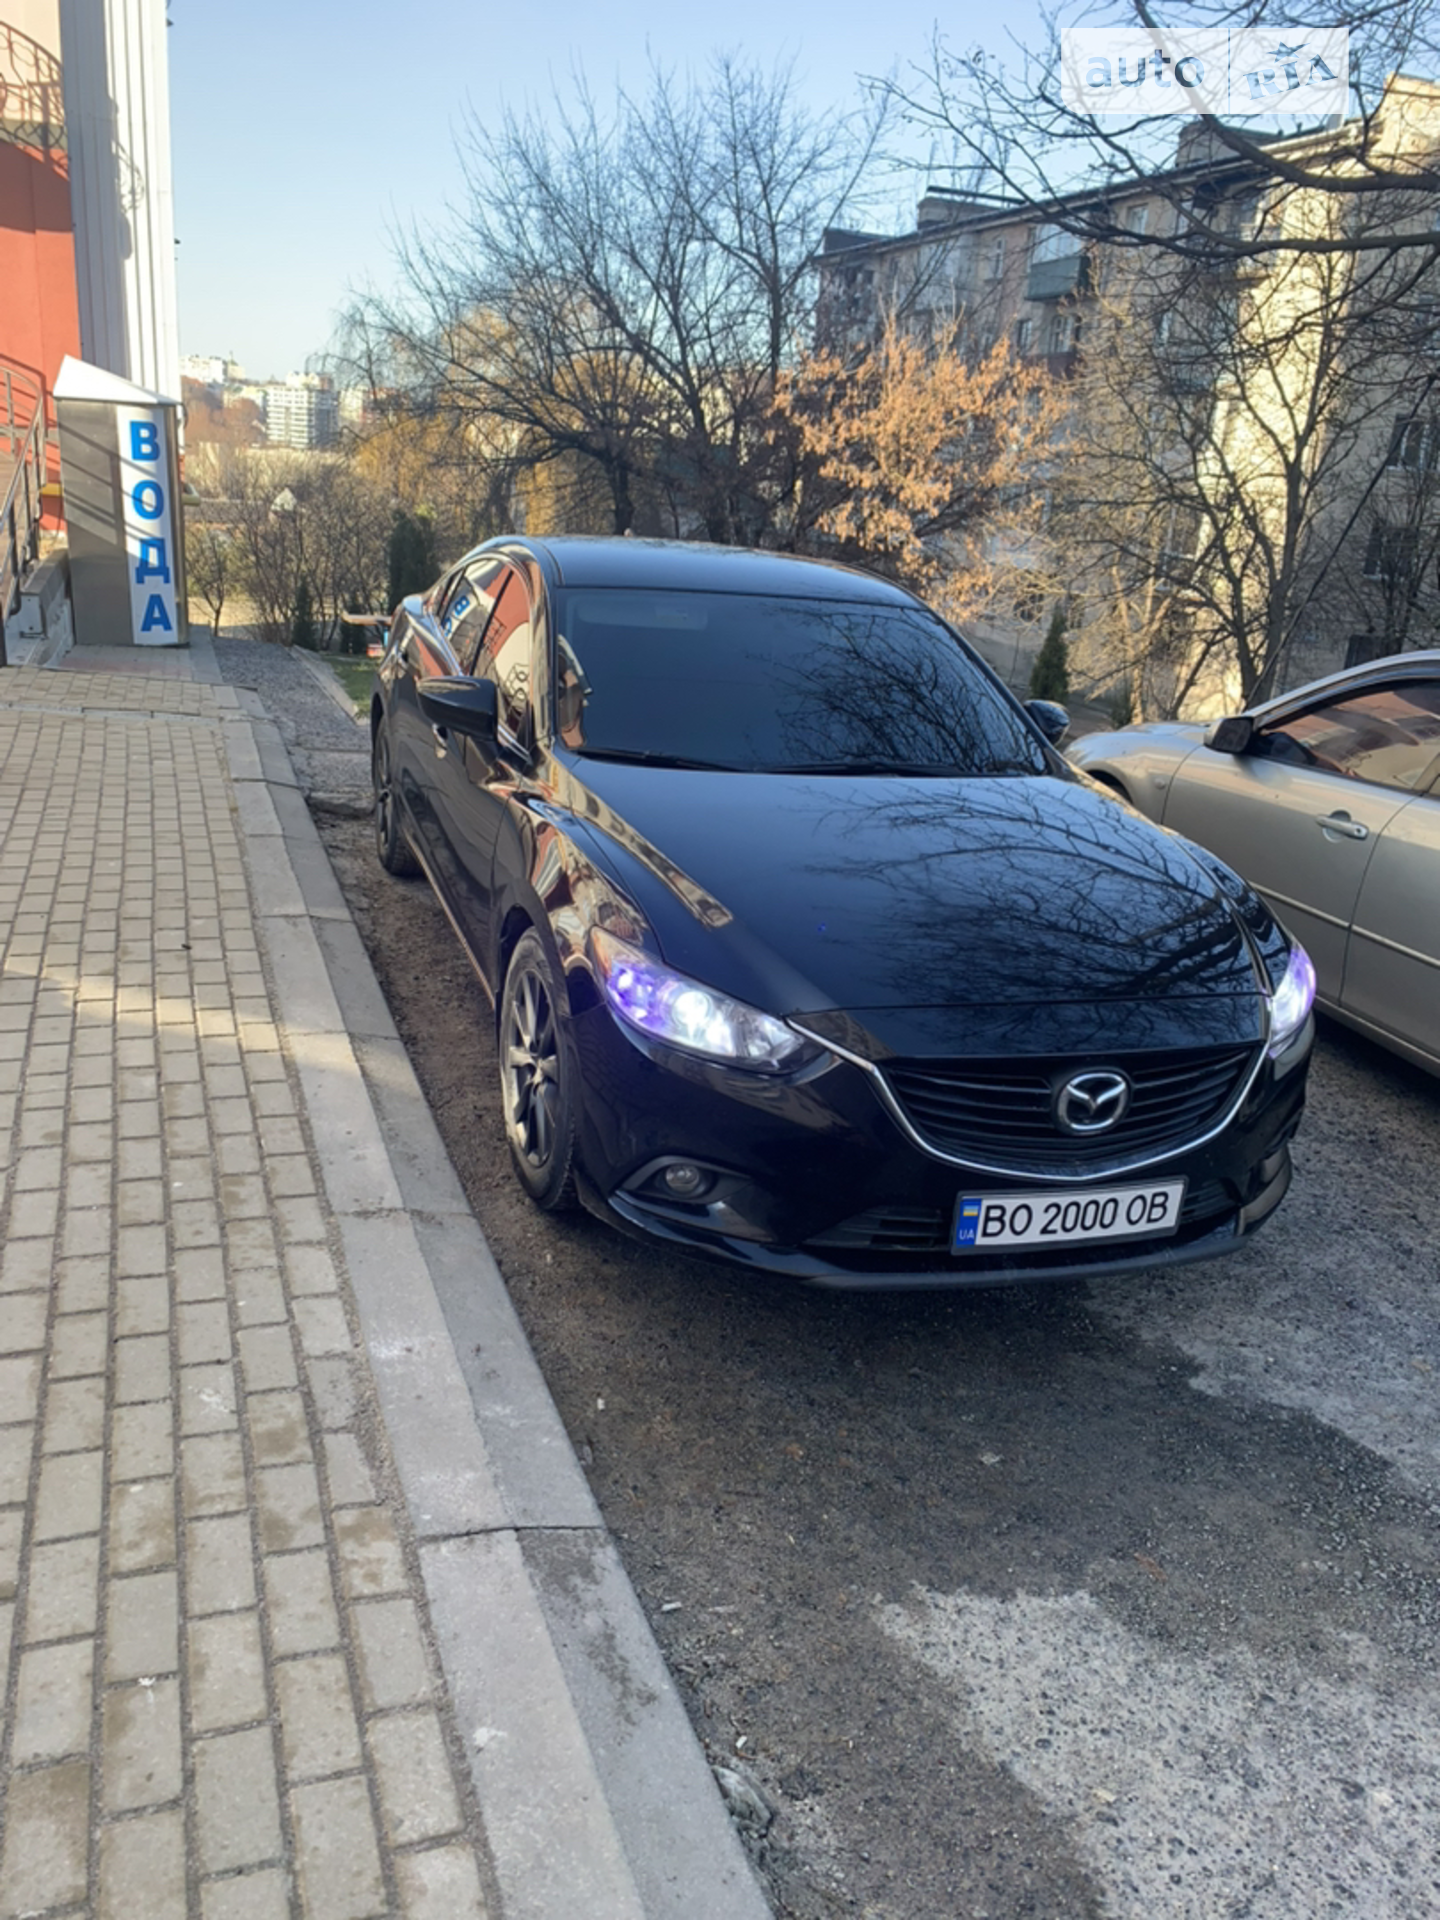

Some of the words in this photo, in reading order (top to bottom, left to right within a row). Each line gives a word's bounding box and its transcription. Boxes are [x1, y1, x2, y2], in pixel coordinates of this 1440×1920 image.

[129, 420, 173, 632] ВОДА
[959, 1228, 975, 1240] UA
[981, 1203, 1033, 1238] BO
[1040, 1197, 1119, 1235] 2000
[1125, 1191, 1169, 1226] OB
